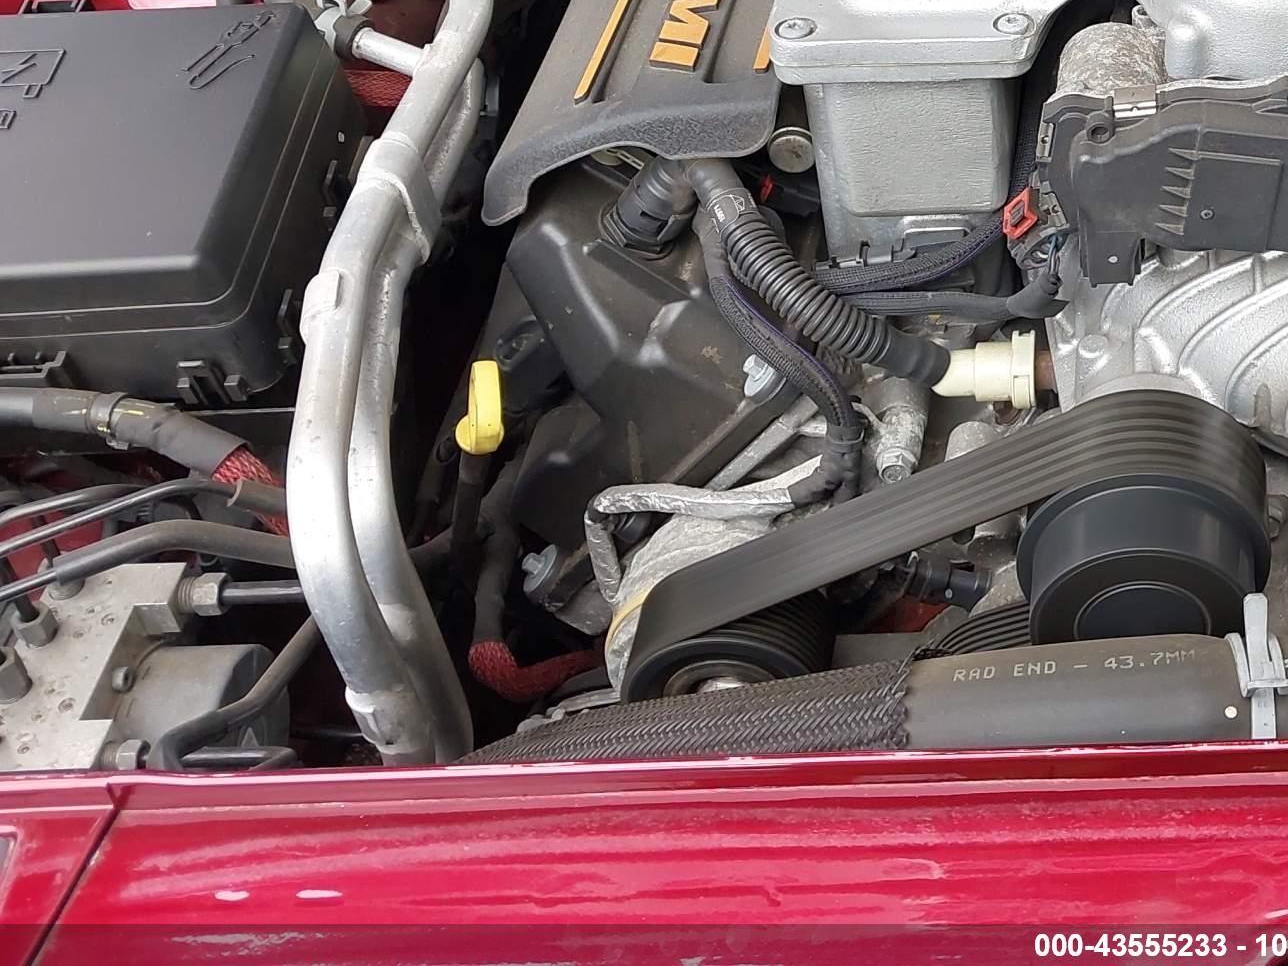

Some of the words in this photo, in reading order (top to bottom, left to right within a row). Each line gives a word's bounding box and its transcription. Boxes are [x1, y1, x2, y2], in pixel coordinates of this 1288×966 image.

[953, 666, 996, 682] RAD
[1013, 661, 1057, 677] END
[1103, 649, 1196, 670] 43.7MM
